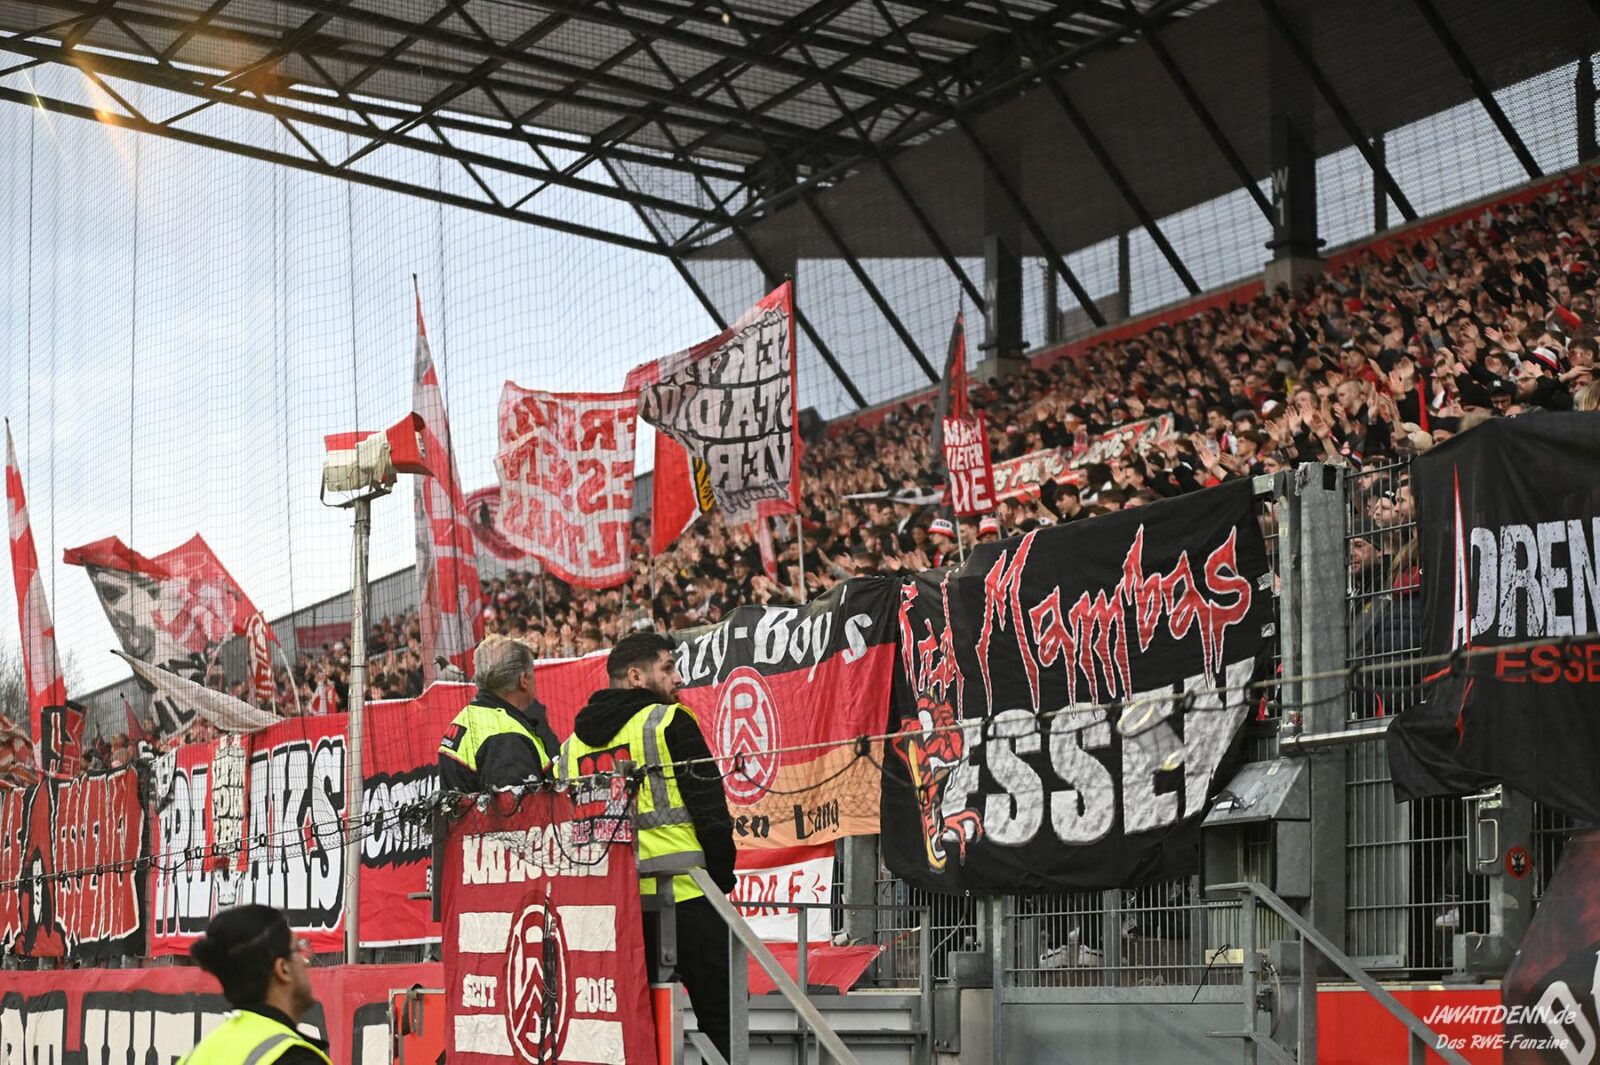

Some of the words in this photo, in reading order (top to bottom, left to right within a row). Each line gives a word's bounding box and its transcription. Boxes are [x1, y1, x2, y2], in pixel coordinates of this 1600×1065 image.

[975, 523, 1252, 720] Mambas
[462, 973, 498, 1009] SEIT
[574, 976, 617, 1014] 2015
